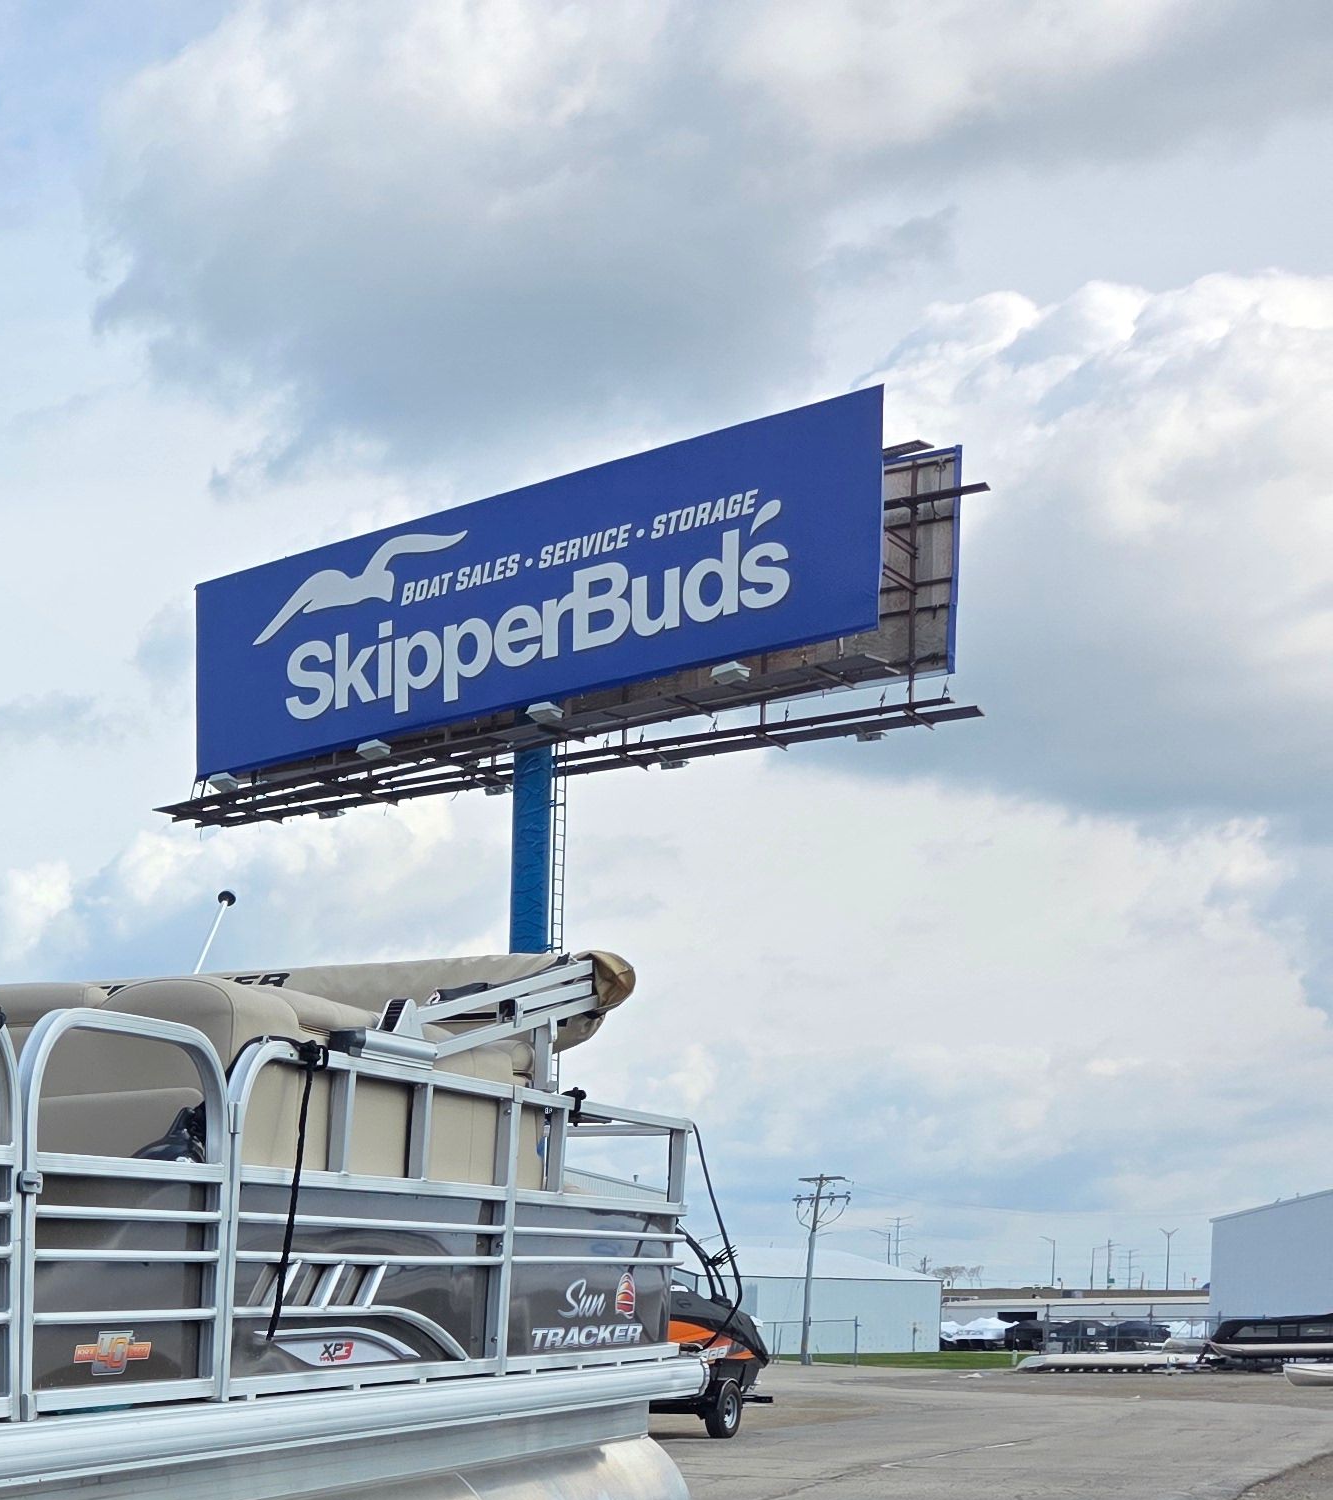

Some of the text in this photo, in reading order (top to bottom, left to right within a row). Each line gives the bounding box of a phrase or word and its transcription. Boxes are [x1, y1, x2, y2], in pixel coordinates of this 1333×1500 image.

[400, 488, 759, 607] BOAT SALES SERVICE STORAGE
[557, 1277, 607, 1318] Sun
[319, 1340, 355, 1362] XP3
[531, 1322, 644, 1350] TRACKER
